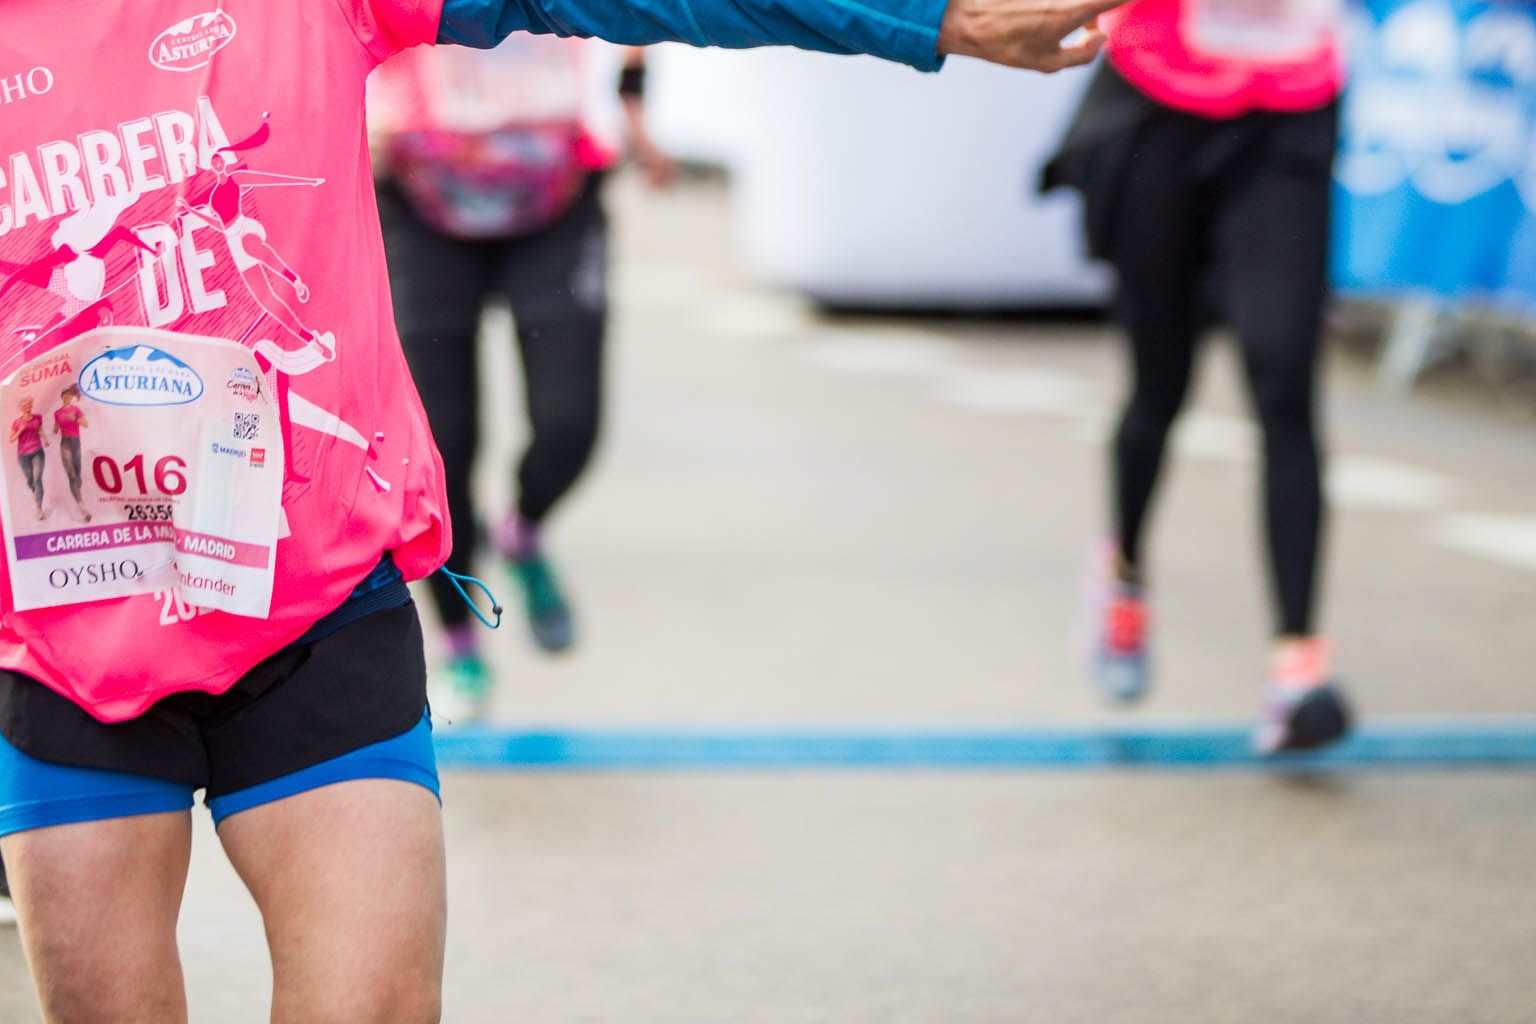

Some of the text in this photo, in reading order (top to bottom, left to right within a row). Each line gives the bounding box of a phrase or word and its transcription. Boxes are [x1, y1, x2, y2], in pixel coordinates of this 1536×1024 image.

[158, 22, 231, 64] ASTURA
[134, 204, 228, 328] DE
[19, 361, 72, 388] SUMA
[87, 368, 193, 397] ASTURIANA
[92, 454, 188, 496] 016
[46, 530, 110, 553] CARRERA
[112, 526, 132, 544] DE
[134, 525, 153, 541] LA
[184, 534, 236, 560] MADRID
[48, 559, 139, 590] OYSHO
